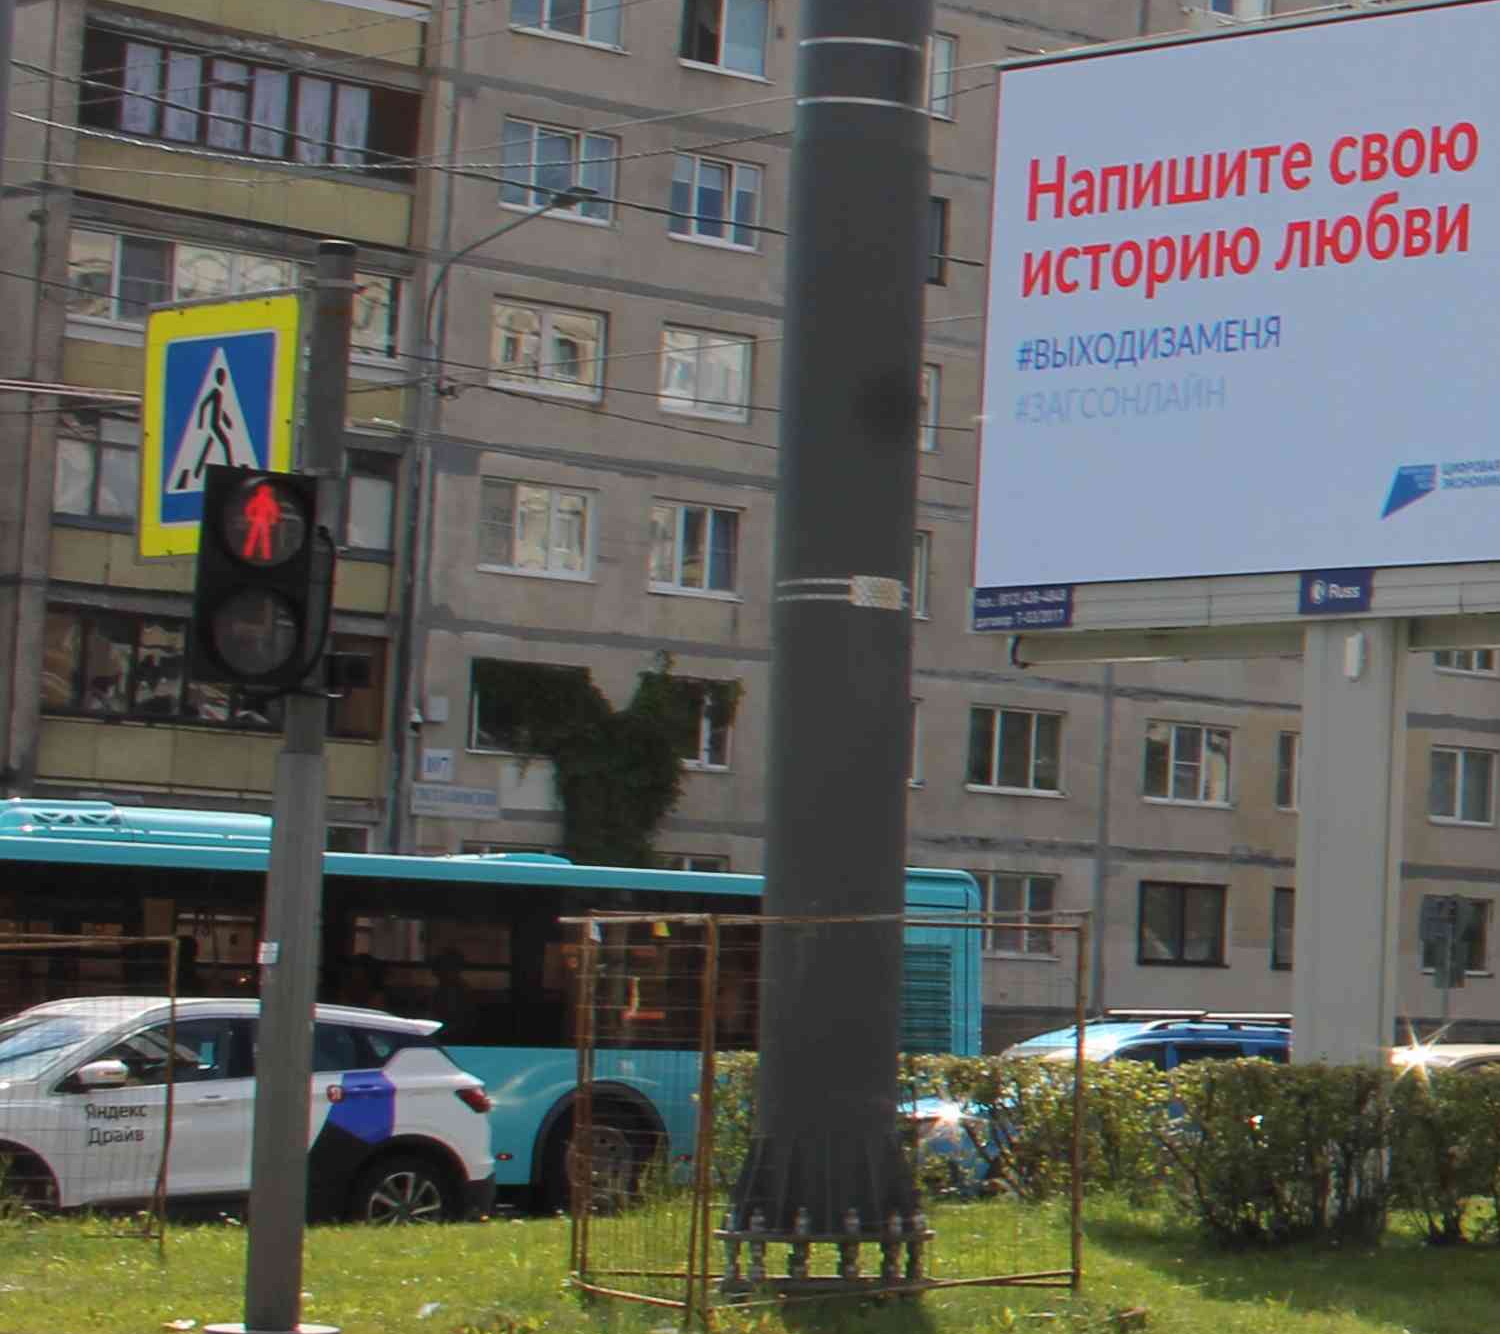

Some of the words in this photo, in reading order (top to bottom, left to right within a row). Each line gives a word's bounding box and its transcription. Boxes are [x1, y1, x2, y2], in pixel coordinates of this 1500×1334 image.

[1026, 141, 1313, 221] Напишите
[1329, 121, 1480, 186] свою
[1021, 226, 1261, 299] историю
[1274, 190, 1471, 271] любви
[1016, 315, 1281, 371] #ВЫХОДИЗАМЕНЯ
[1015, 371, 1226, 424] #ЗАГСОНЛАЙН
[85, 1103, 147, 1120] Яндекс
[87, 1125, 145, 1146] Драйв
